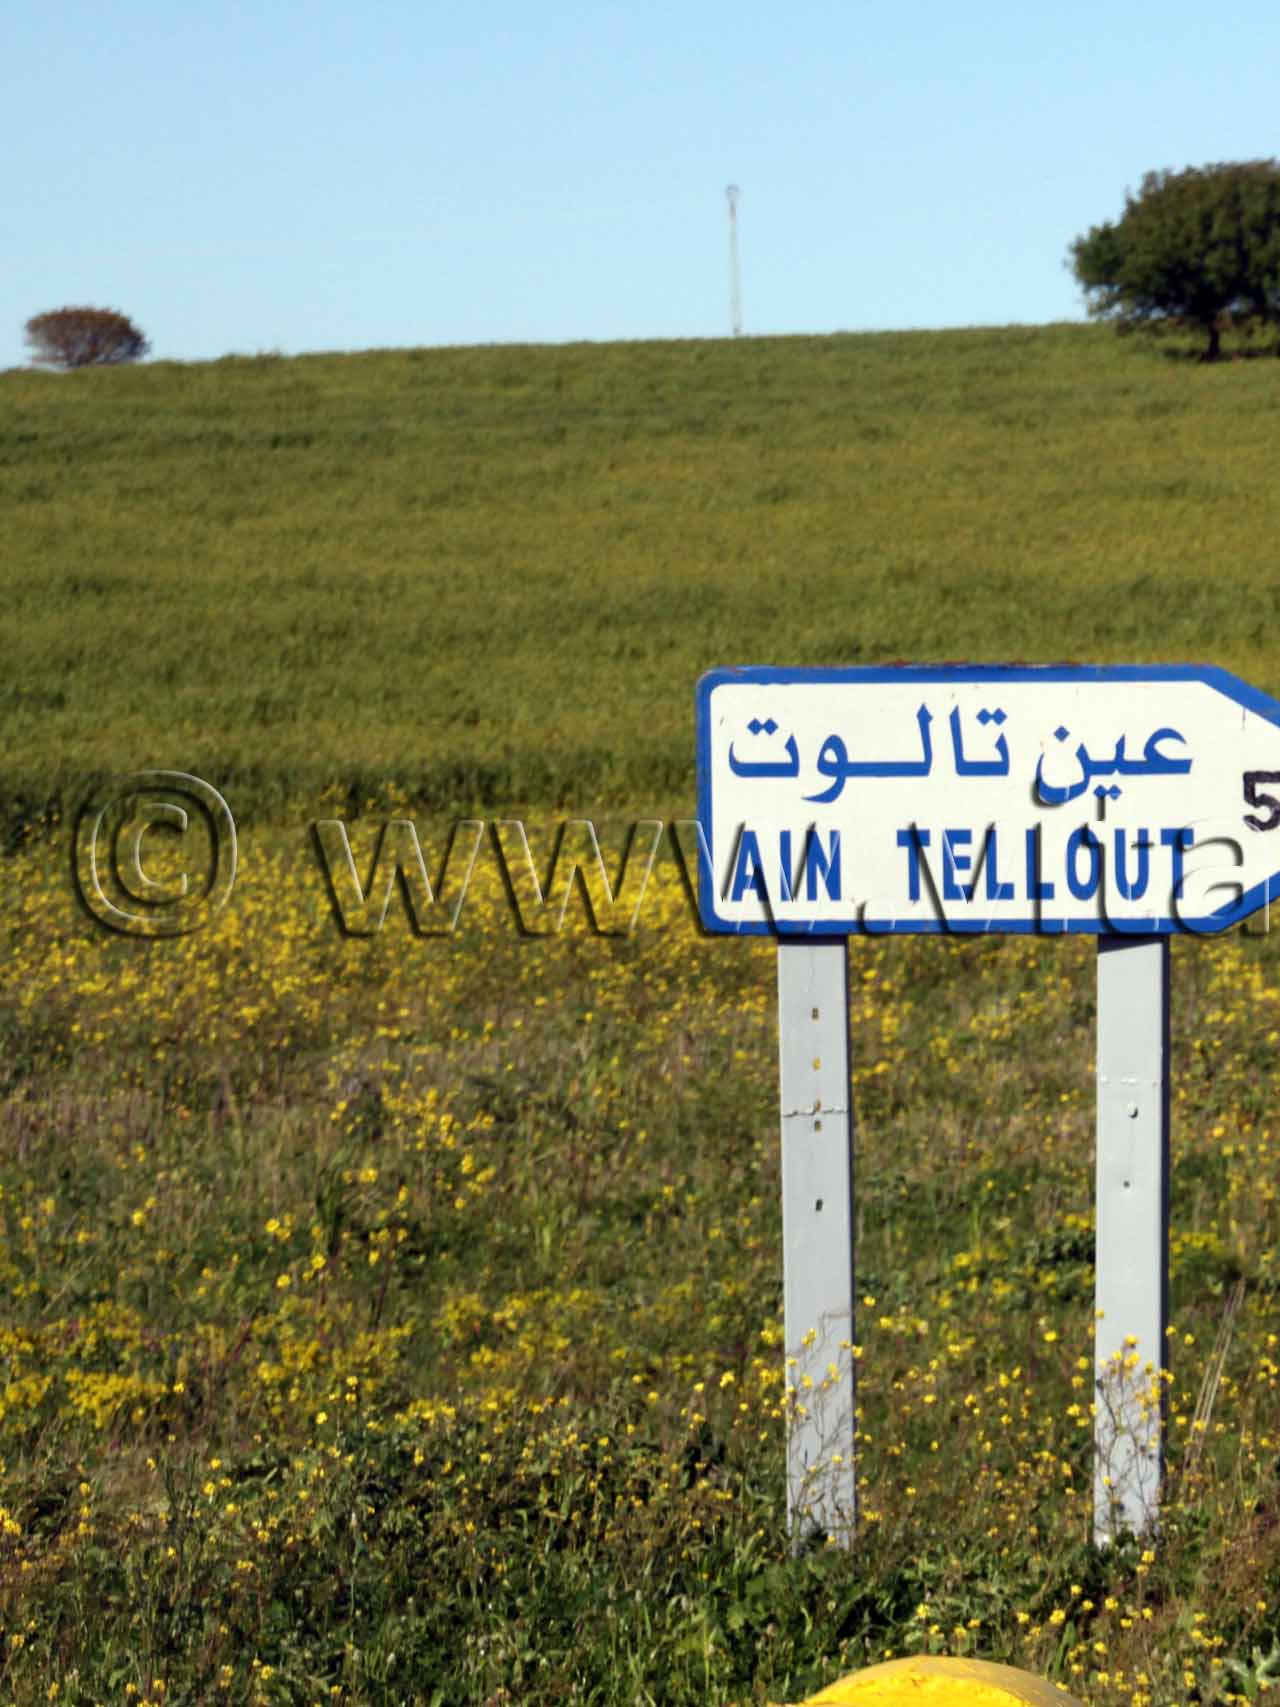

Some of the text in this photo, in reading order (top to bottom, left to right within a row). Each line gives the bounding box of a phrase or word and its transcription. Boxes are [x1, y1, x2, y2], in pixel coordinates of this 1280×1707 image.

[728, 702, 1194, 804] عين تالوت
[730, 827, 1195, 902] AIN TELLOUT
